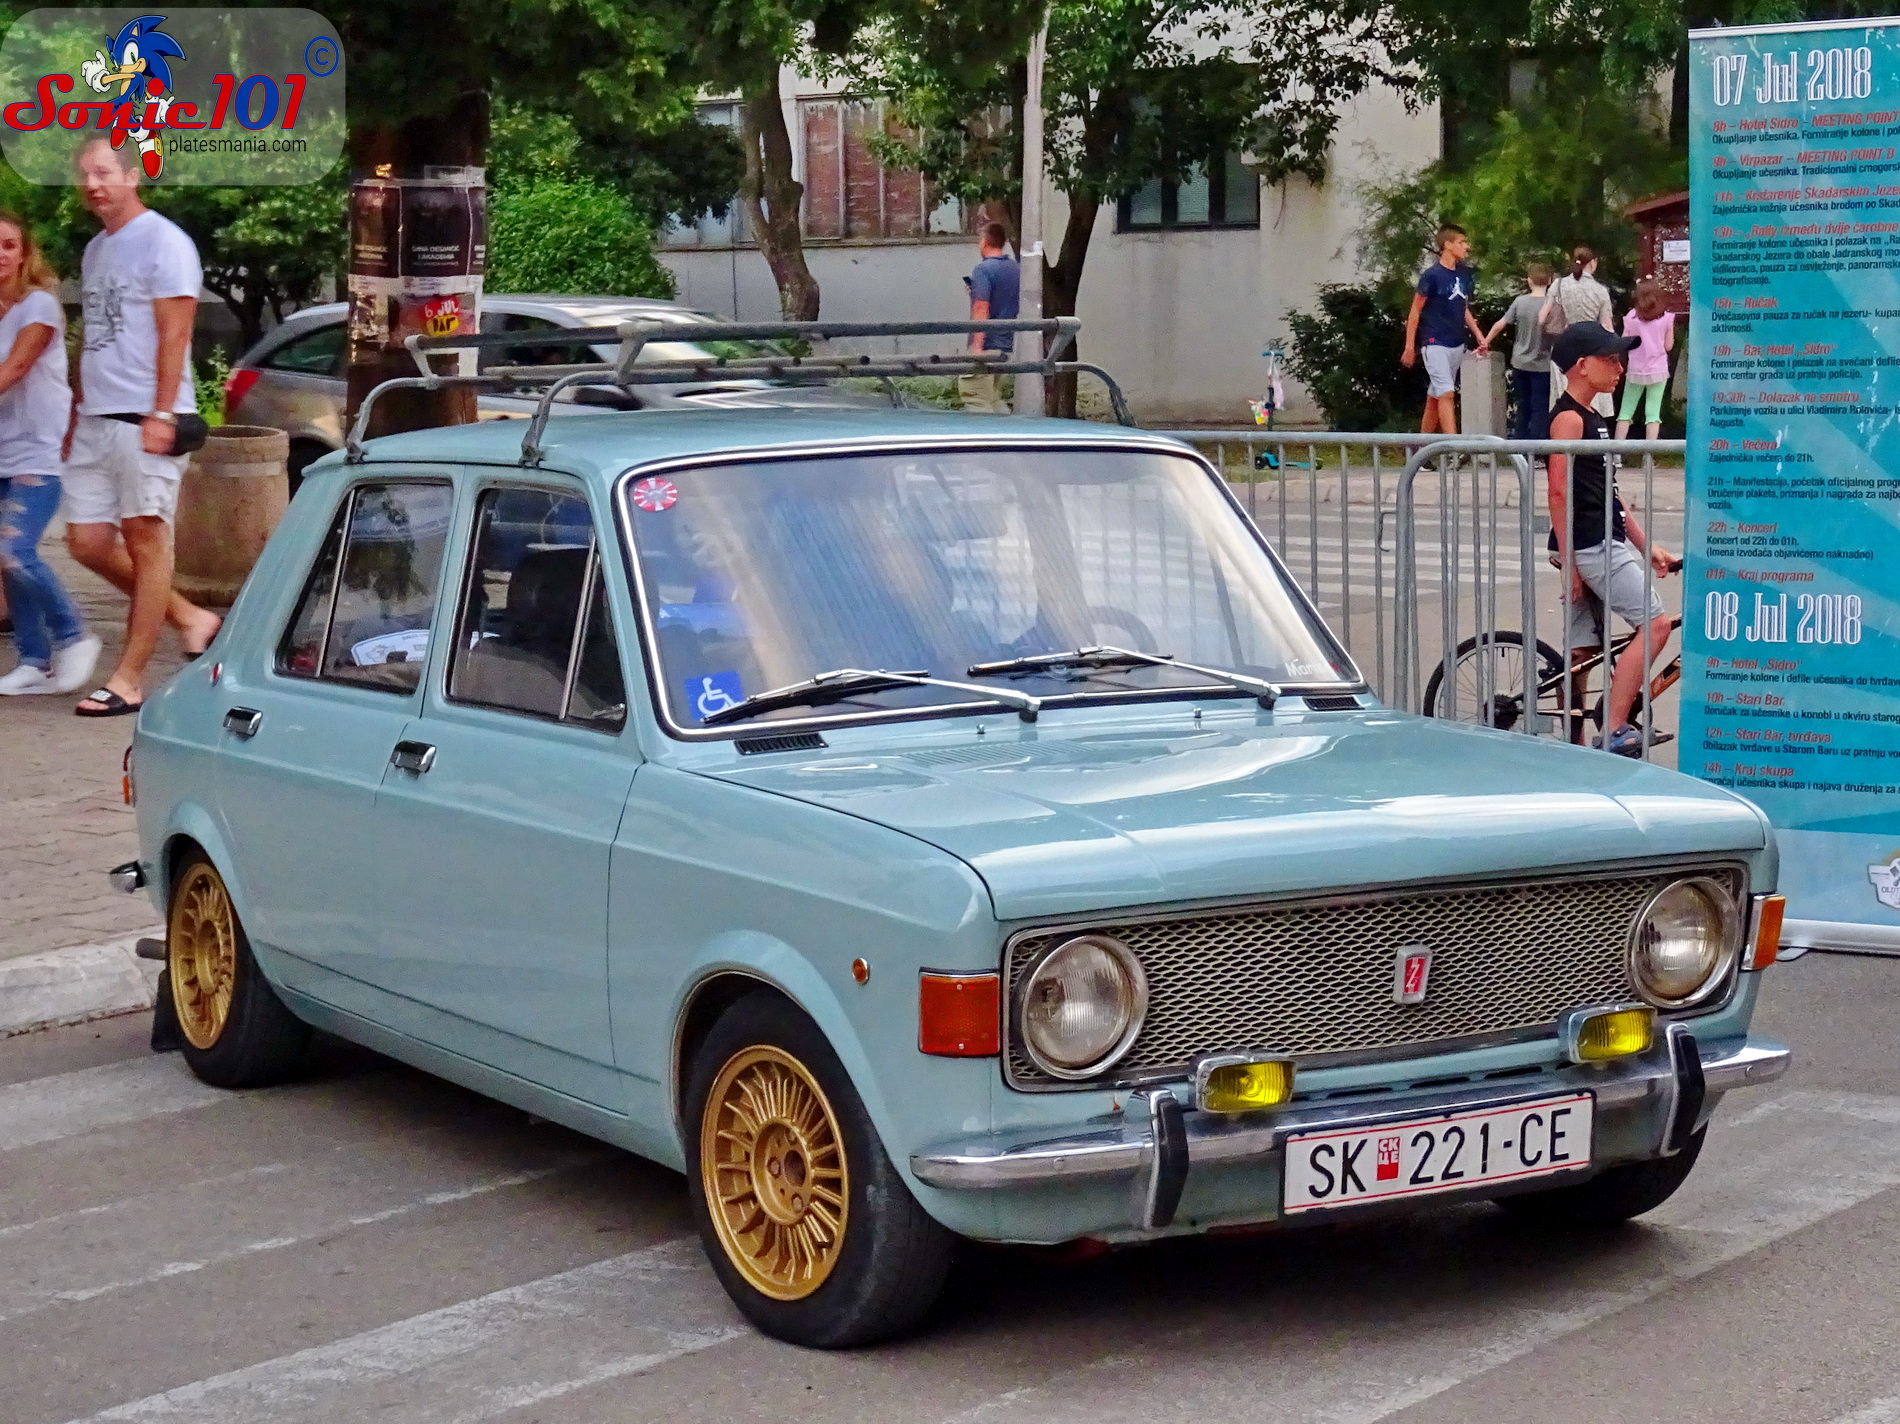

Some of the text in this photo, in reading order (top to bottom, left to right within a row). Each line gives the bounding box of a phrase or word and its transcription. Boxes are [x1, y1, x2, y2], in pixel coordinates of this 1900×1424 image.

[1714, 47, 1871, 106] 07 Jul 2018
[1740, 119, 1767, 130] Hotel
[1770, 118, 1798, 129] Sidro
[1812, 113, 1862, 126] MEETING
[1866, 111, 1900, 124] POINT
[1712, 133, 1756, 144] Okupljanje
[1802, 129, 1848, 139] Formiranje
[1852, 128, 1880, 137] kolone
[1740, 154, 1783, 168] Virpazar
[1797, 150, 1847, 162] MEETING
[1851, 148, 1884, 160] POINT
[1712, 168, 1756, 180] Okupljanje
[1804, 186, 1870, 199] Skadarskim
[1789, 202, 1828, 211] učesnika
[1831, 200, 1863, 210] brodom
[1866, 200, 1876, 209] po
[1712, 235, 1881, 251] Formiranje kolone učesnika polazak na
[1794, 250, 1805, 259] do
[1832, 247, 1882, 258] Jadranskog
[1763, 312, 1788, 320] pauza
[1791, 312, 1800, 320] za
[1711, 358, 1755, 370] Formiranje
[1826, 358, 1836, 366] na
[1711, 371, 1729, 380] kroz
[1731, 371, 1756, 380] centar
[1759, 392, 1800, 403] Dolazak
[1710, 406, 1752, 416] Parkiranje
[1787, 405, 1804, 415] ulici
[1806, 405, 1847, 415] Vladimira
[1785, 454, 1795, 463] do
[1797, 453, 1815, 463] 21h.
[1708, 477, 1724, 486] 21h
[1708, 488, 1743, 498] Uručenje
[1826, 490, 1862, 500] nagrada
[1707, 522, 1778, 534] 22h Koncert
[1707, 536, 1738, 545] Koncert
[1752, 537, 1767, 545] 22h
[1769, 537, 1780, 545] do
[1826, 550, 1874, 560] naknadno)
[1760, 571, 1814, 584] programa
[1705, 591, 1861, 644] 08 Jul 2018
[1730, 658, 1758, 669] Hotel
[1706, 671, 1867, 685] Formiranje kolone defile učesnika do
[1736, 693, 1761, 705] Stari
[1740, 708, 1749, 716] za
[1752, 708, 1790, 718] učesnike
[1801, 710, 1832, 720] konobi
[1843, 712, 1870, 721] okviru
[1736, 728, 1761, 740] Stari
[1703, 741, 1737, 750] Obilazak
[1782, 744, 1815, 754] Starom
[1818, 746, 1838, 755] Baru
[1853, 748, 1885, 759] pratnju
[1760, 765, 1794, 778] skupa
[1737, 779, 1776, 788] učesnika
[1778, 780, 1805, 790] skupa
[1813, 783, 1842, 792] najava
[1844, 784, 1883, 794] druženja
[1308, 1108, 1572, 1198] SK 221-CE
